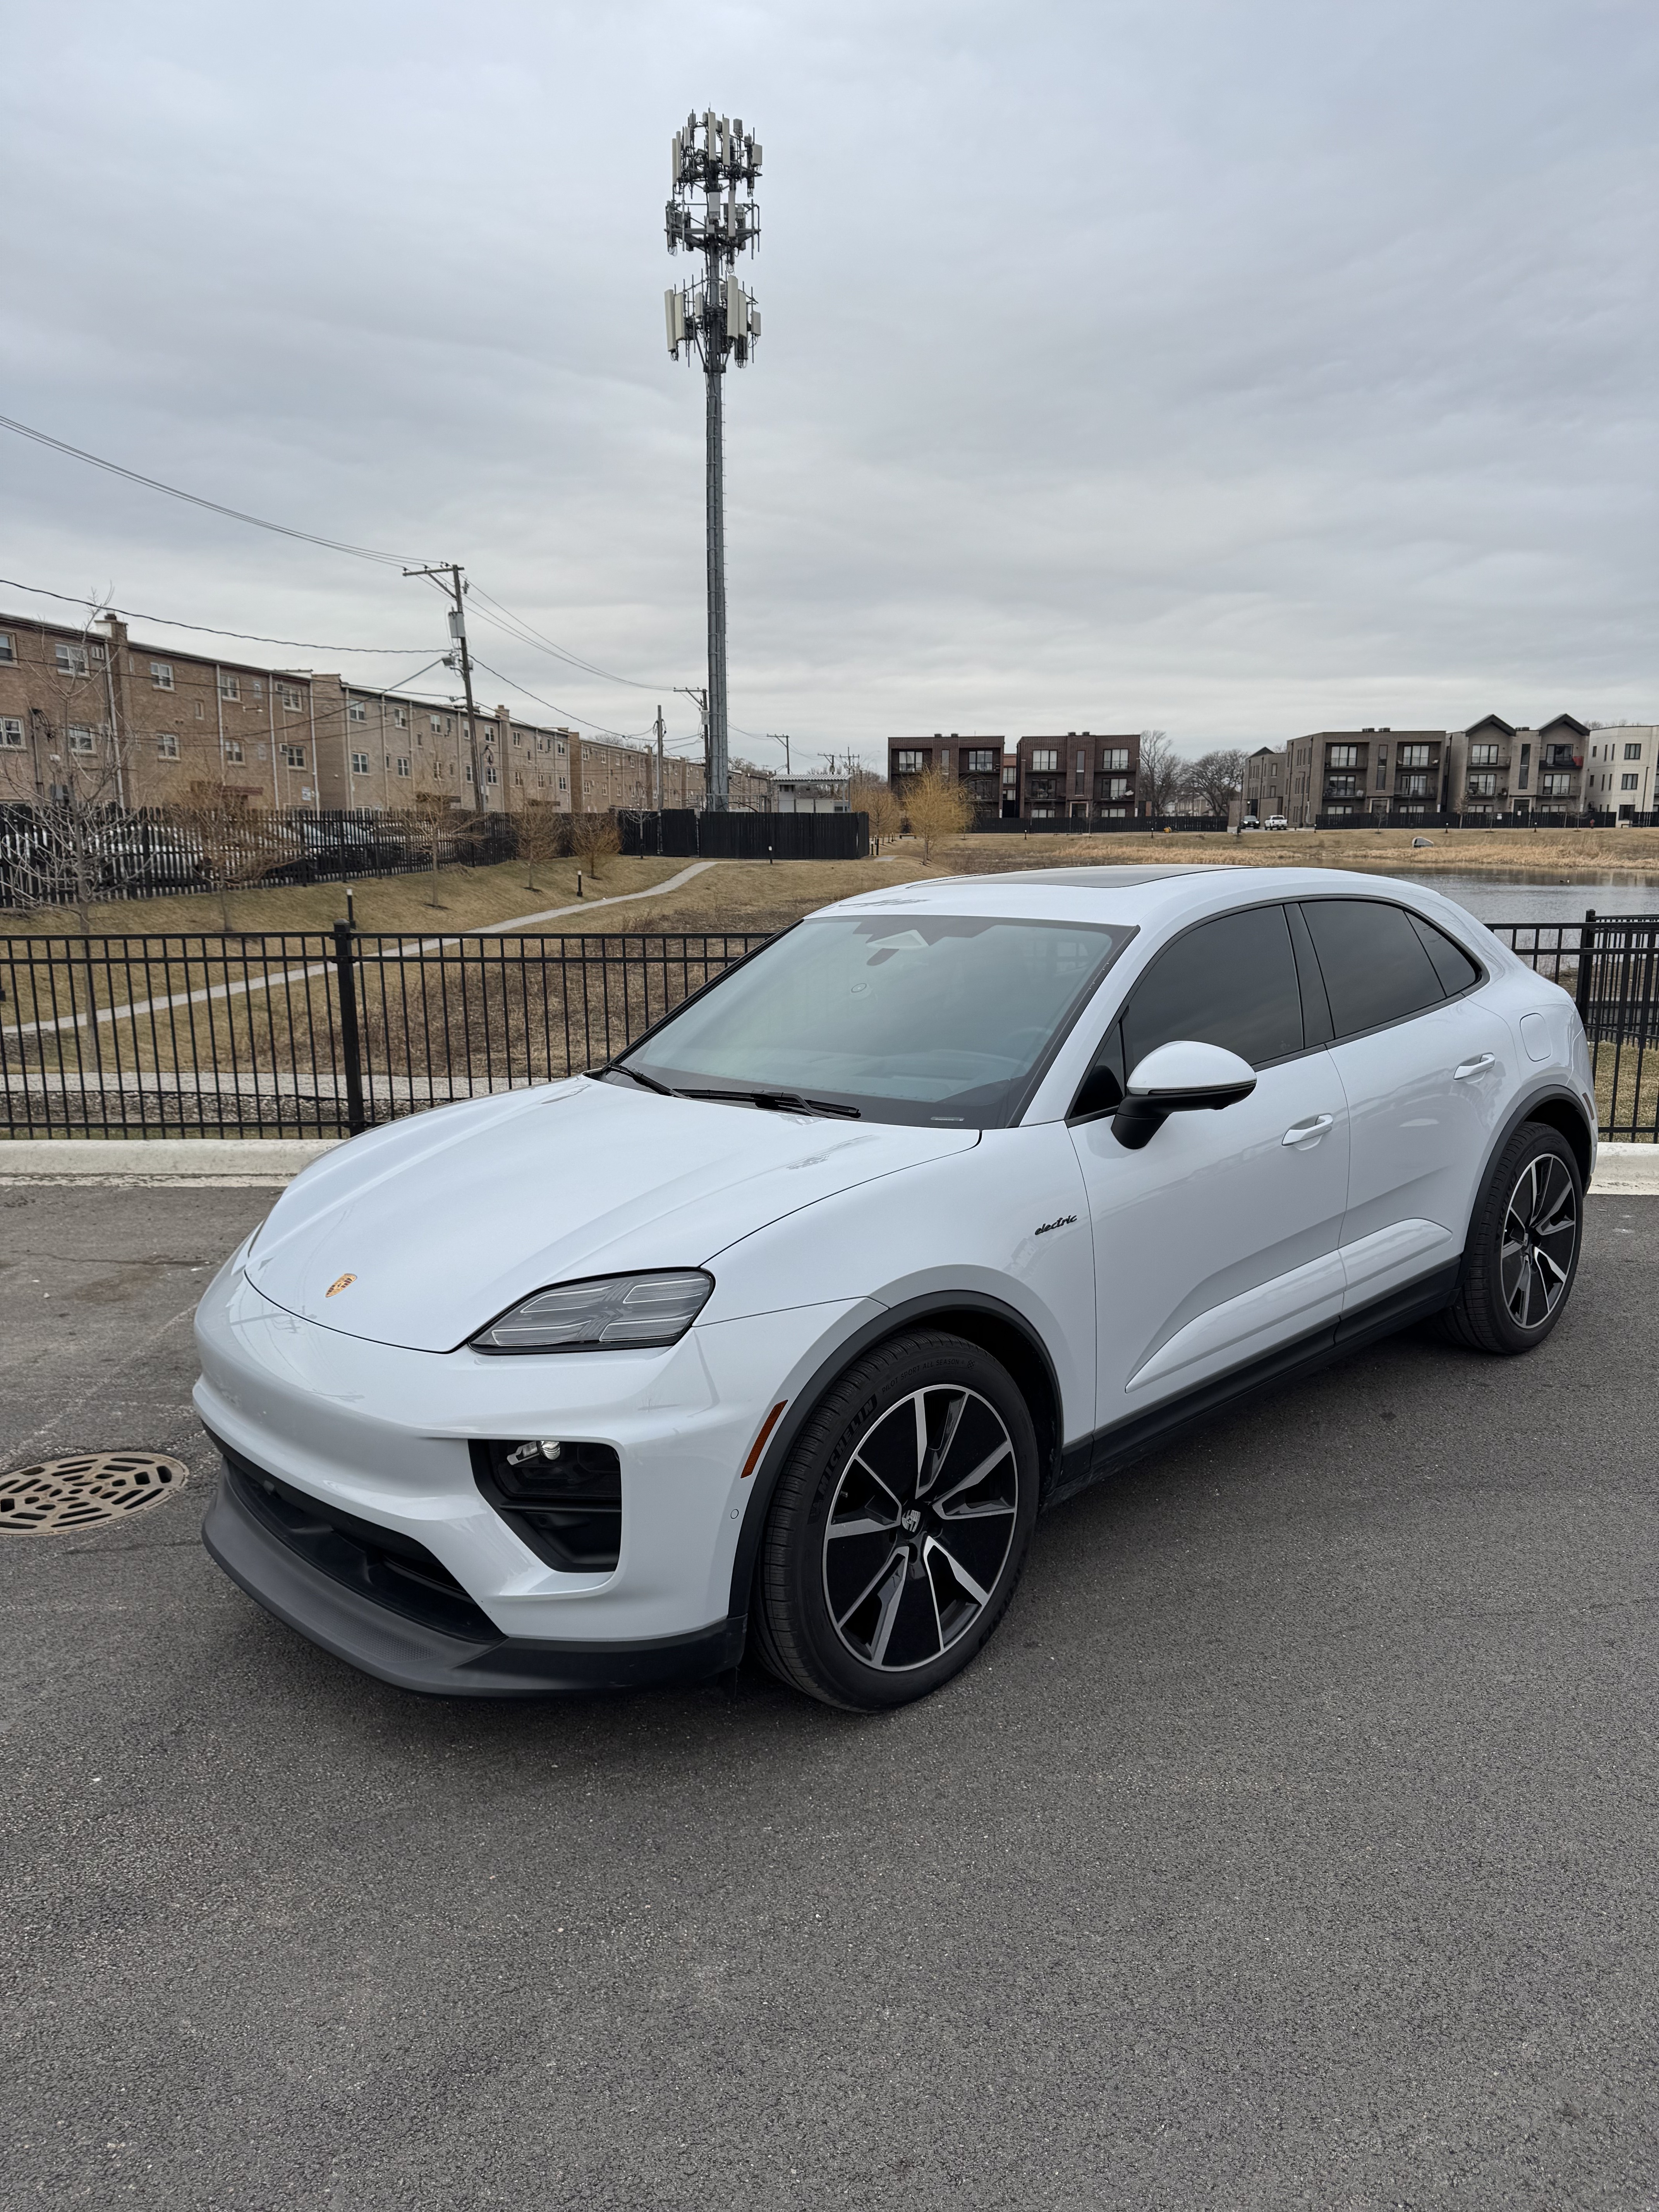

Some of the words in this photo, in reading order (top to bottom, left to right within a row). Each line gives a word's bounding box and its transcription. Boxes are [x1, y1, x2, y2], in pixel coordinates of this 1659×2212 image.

[1034, 1215, 1077, 1235] electric
[882, 1376, 898, 1395] PILOT
[900, 1365, 920, 1380] SPORT
[922, 1361, 934, 1369] ALL
[817, 1398, 874, 1495] MICHELIN
